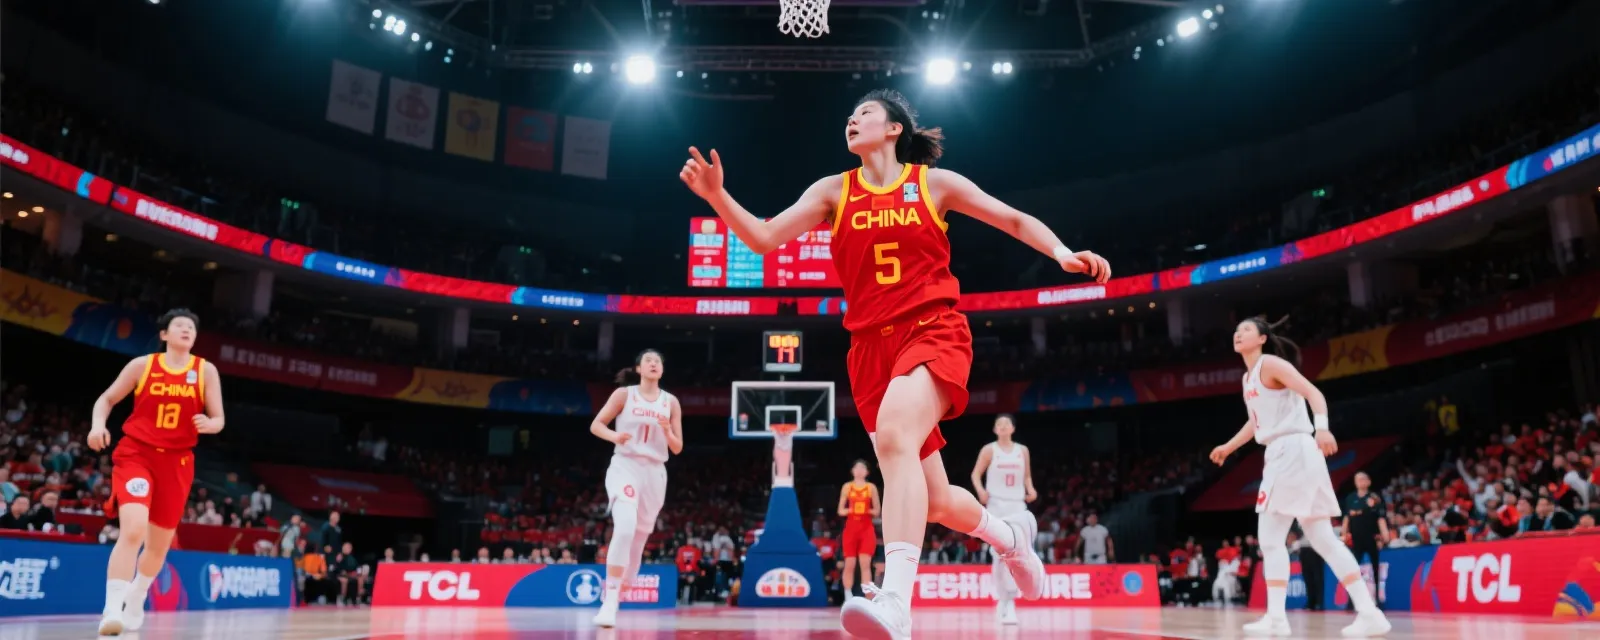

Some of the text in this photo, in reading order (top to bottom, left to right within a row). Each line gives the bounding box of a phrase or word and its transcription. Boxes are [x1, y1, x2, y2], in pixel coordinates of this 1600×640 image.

[851, 207, 922, 230] CHINA
[873, 242, 901, 285] 5
[150, 382, 196, 399] CHINA
[403, 570, 480, 601] TCL
[1452, 553, 1521, 604] TCL
